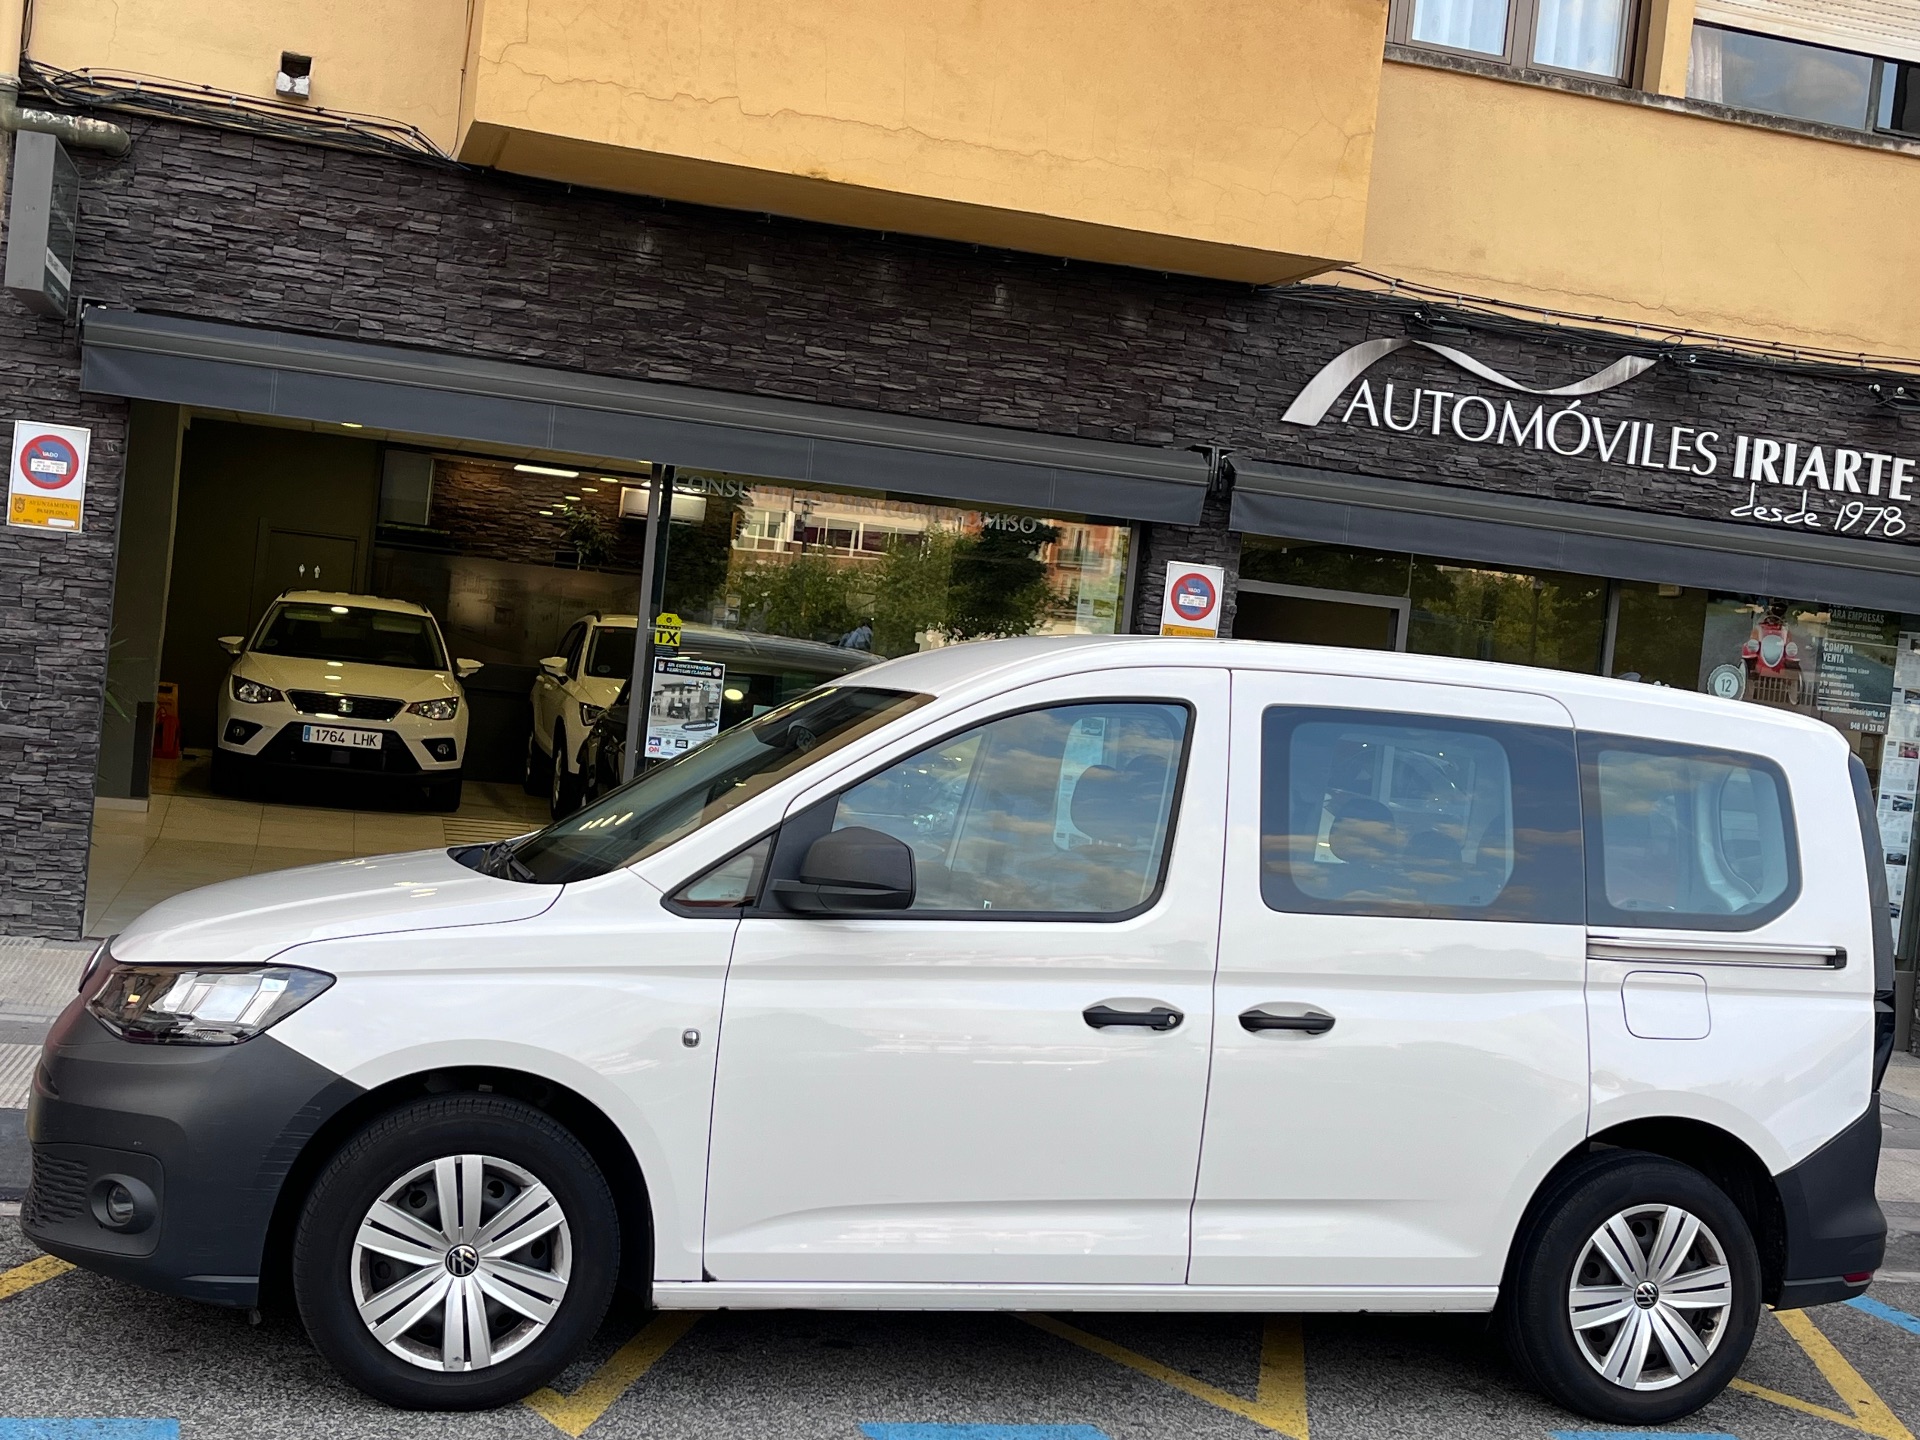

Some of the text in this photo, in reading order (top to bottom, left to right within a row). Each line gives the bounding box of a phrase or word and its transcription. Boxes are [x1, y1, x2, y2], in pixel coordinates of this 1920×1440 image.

[1341, 378, 1916, 500] AUTOMÓVILES IRIARTE
[42, 450, 59, 458] VADO
[1730, 482, 1906, 537] desde 1978
[1828, 608, 1846, 620] PARA
[1847, 610, 1885, 624] EMPRESAS
[656, 630, 678, 645] TX
[1823, 642, 1854, 655] COMPRA
[1822, 652, 1845, 664] VENTA
[1721, 678, 1732, 693] 12
[1861, 723, 1868, 731] 14
[315, 729, 377, 746] 1764 LHK
